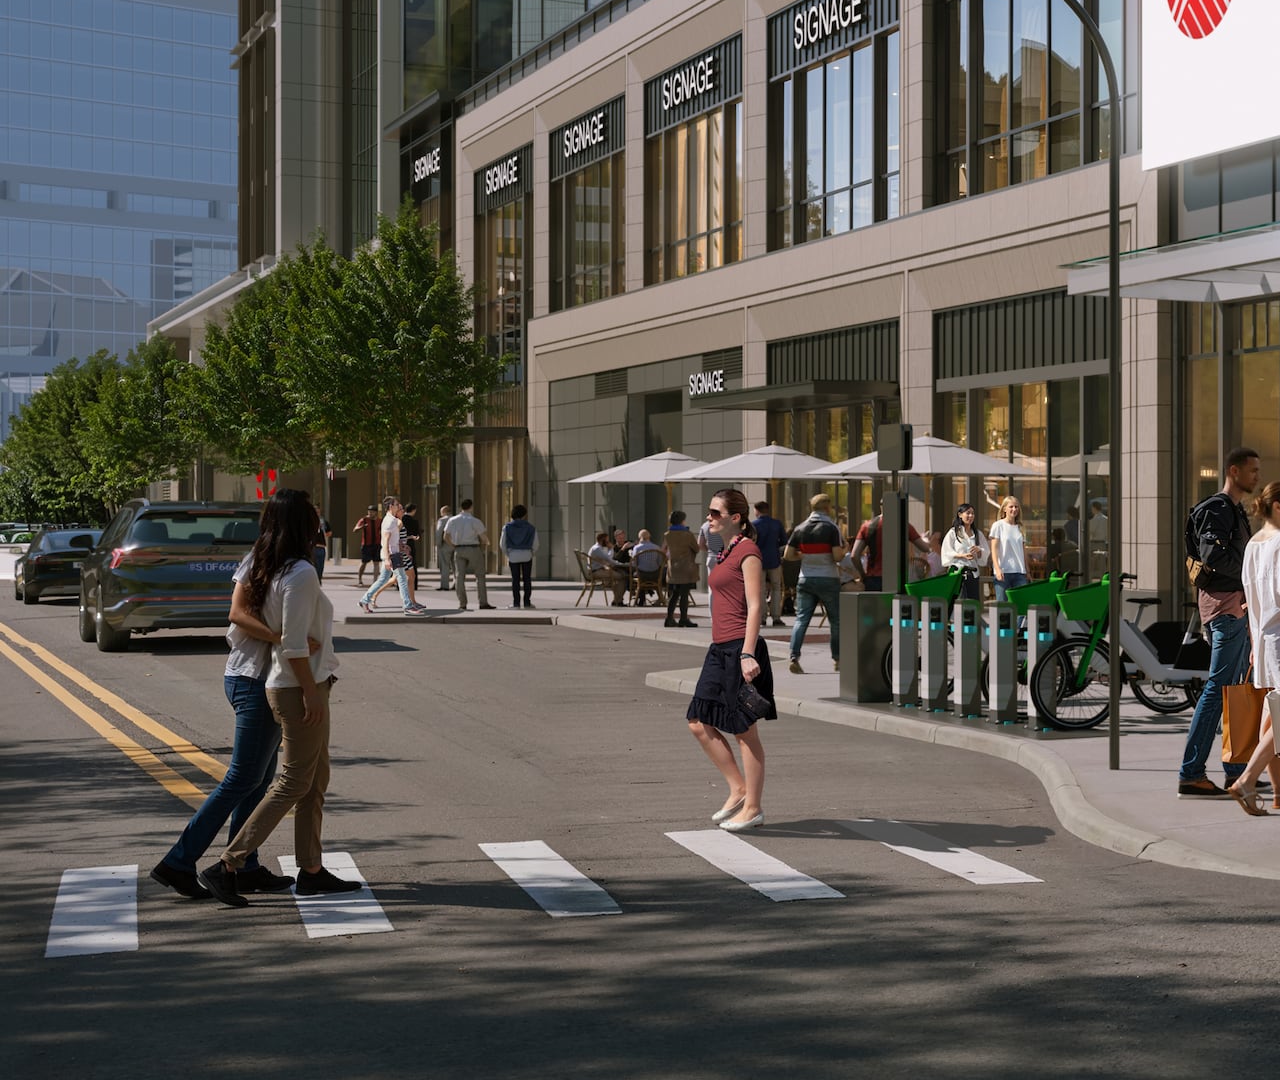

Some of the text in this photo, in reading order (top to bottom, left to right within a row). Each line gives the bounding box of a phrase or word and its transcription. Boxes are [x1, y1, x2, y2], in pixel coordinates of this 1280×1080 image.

[662, 55, 715, 112] SIGNAGE
[563, 112, 604, 159] SIGNAGE
[414, 147, 441, 183] SIGNAGE
[484, 155, 518, 196] SIGNAGE
[688, 369, 725, 397] SIGNAGE
